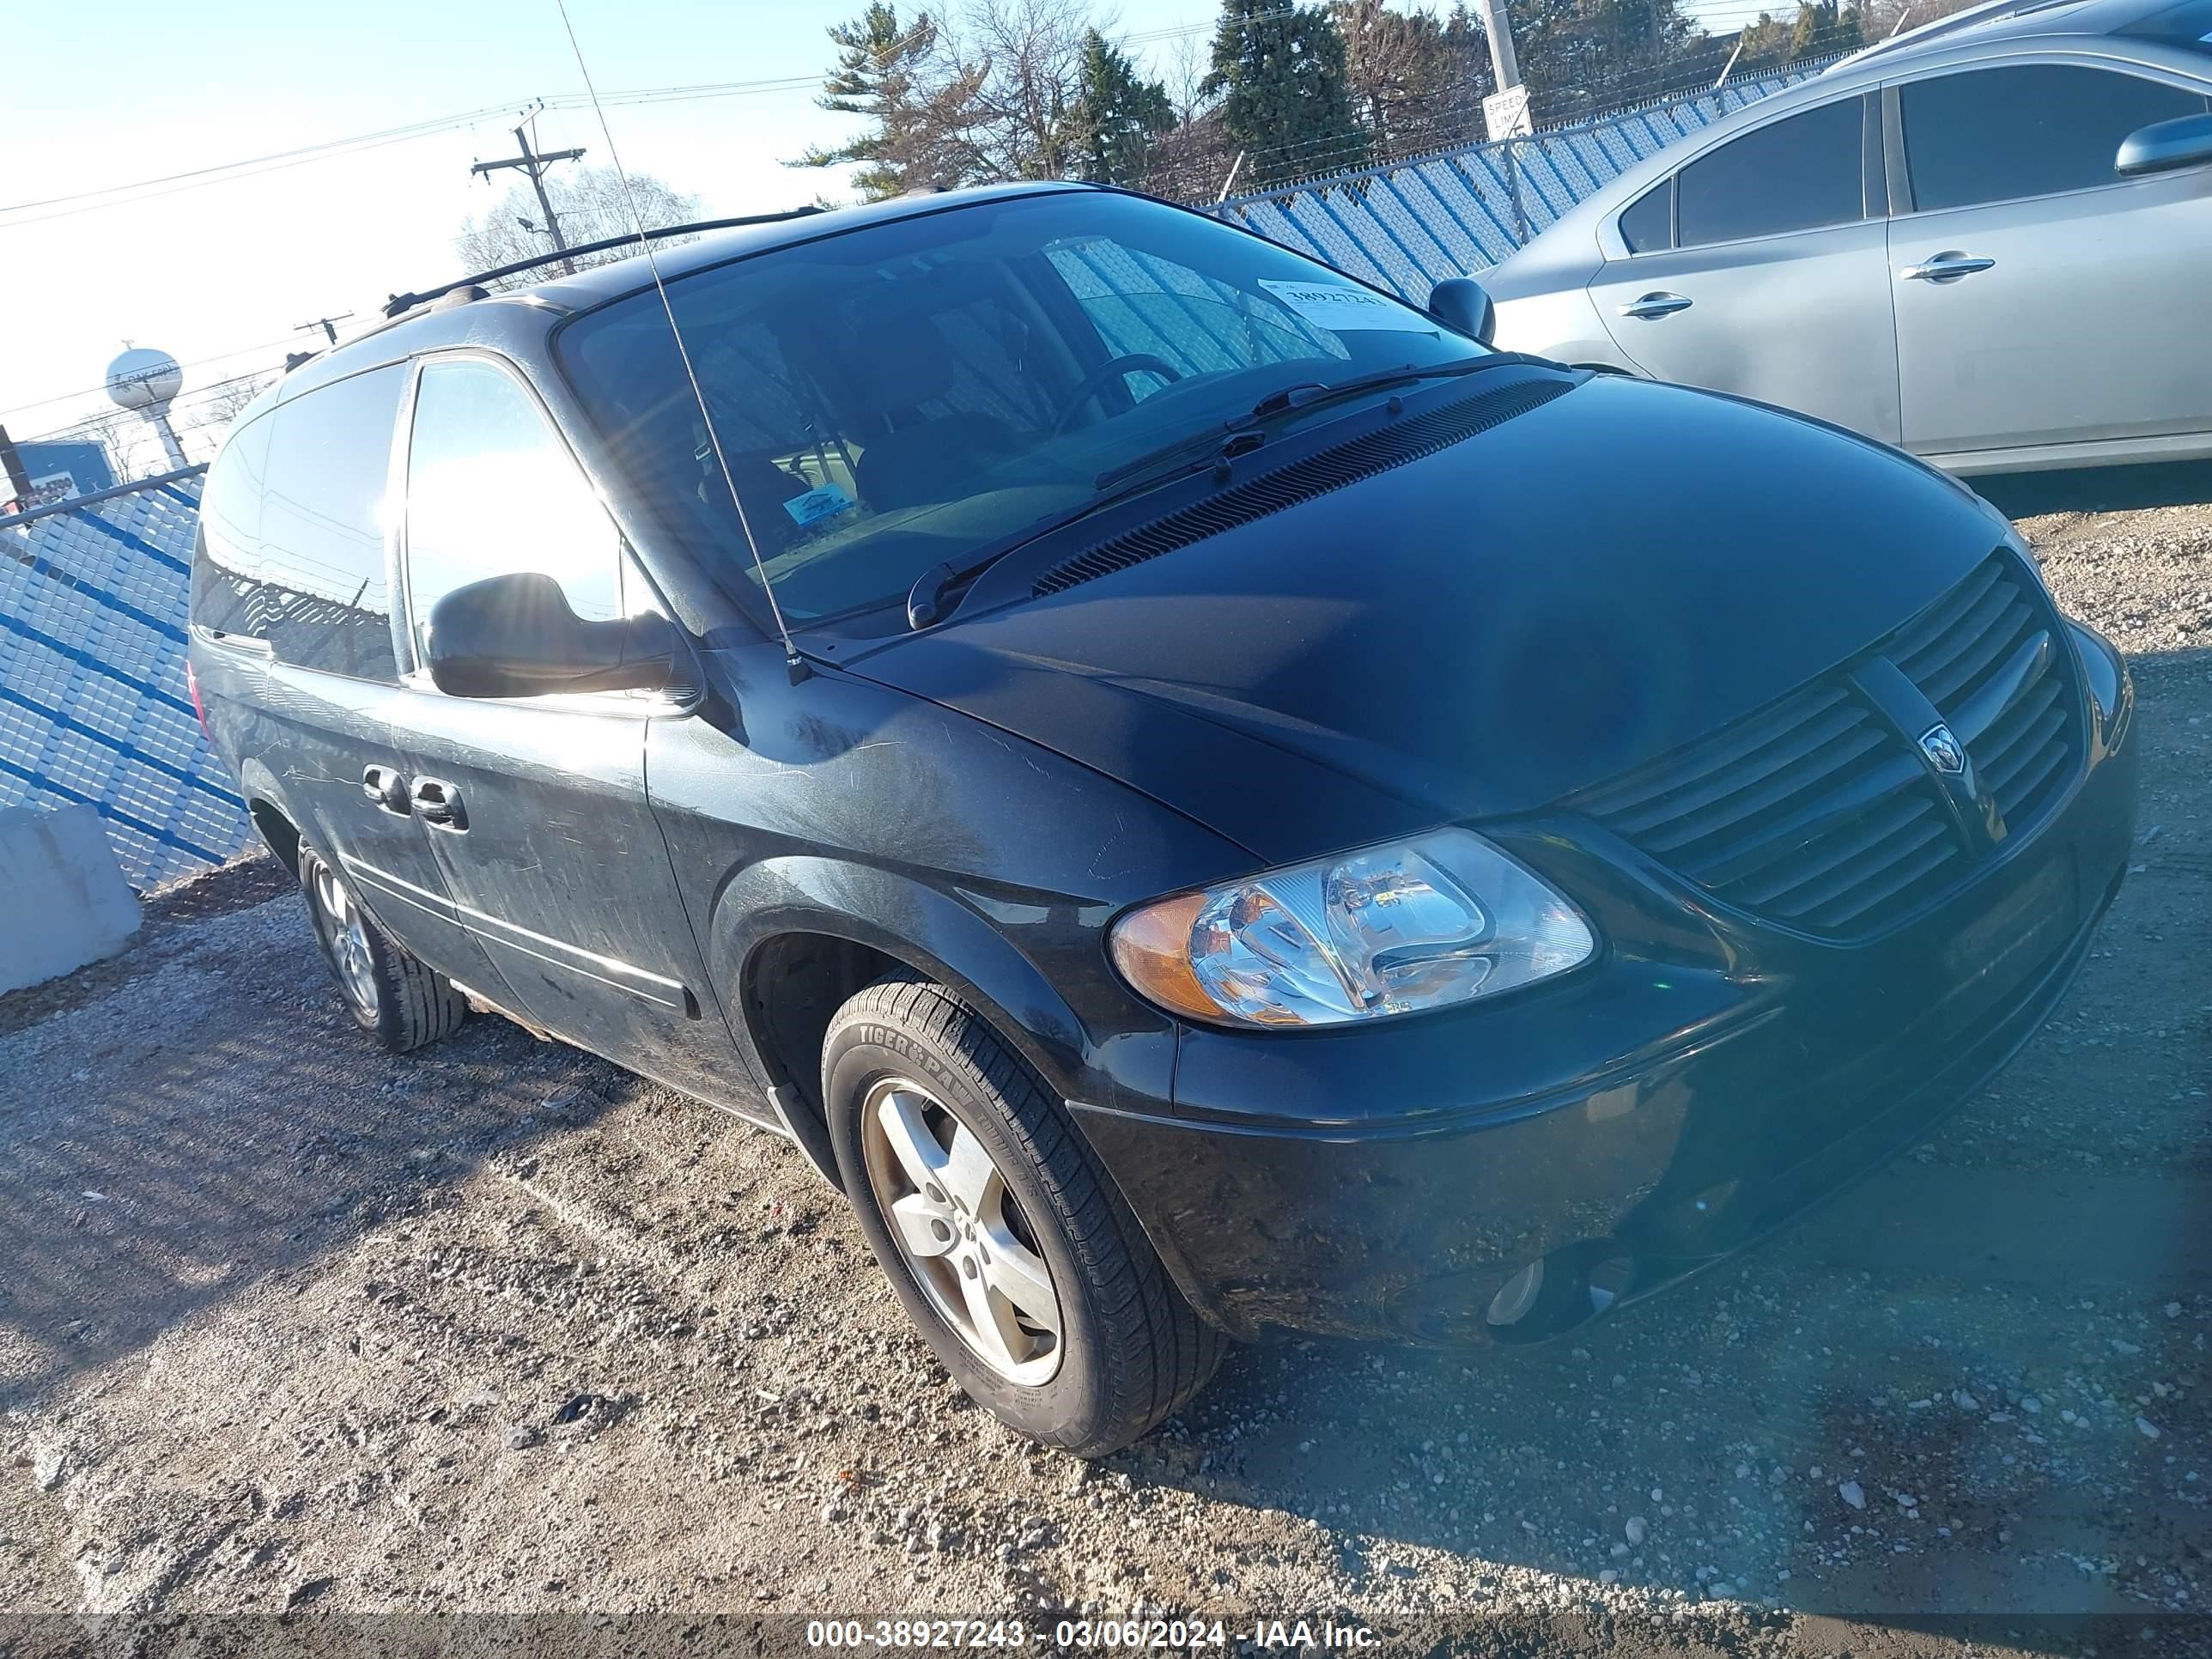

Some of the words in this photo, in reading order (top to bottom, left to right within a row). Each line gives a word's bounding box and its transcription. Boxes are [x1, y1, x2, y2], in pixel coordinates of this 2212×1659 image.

[1489, 95, 1522, 115] SPEED
[860, 1025, 909, 1054] TIGER
[924, 1056, 975, 1107] PAW
